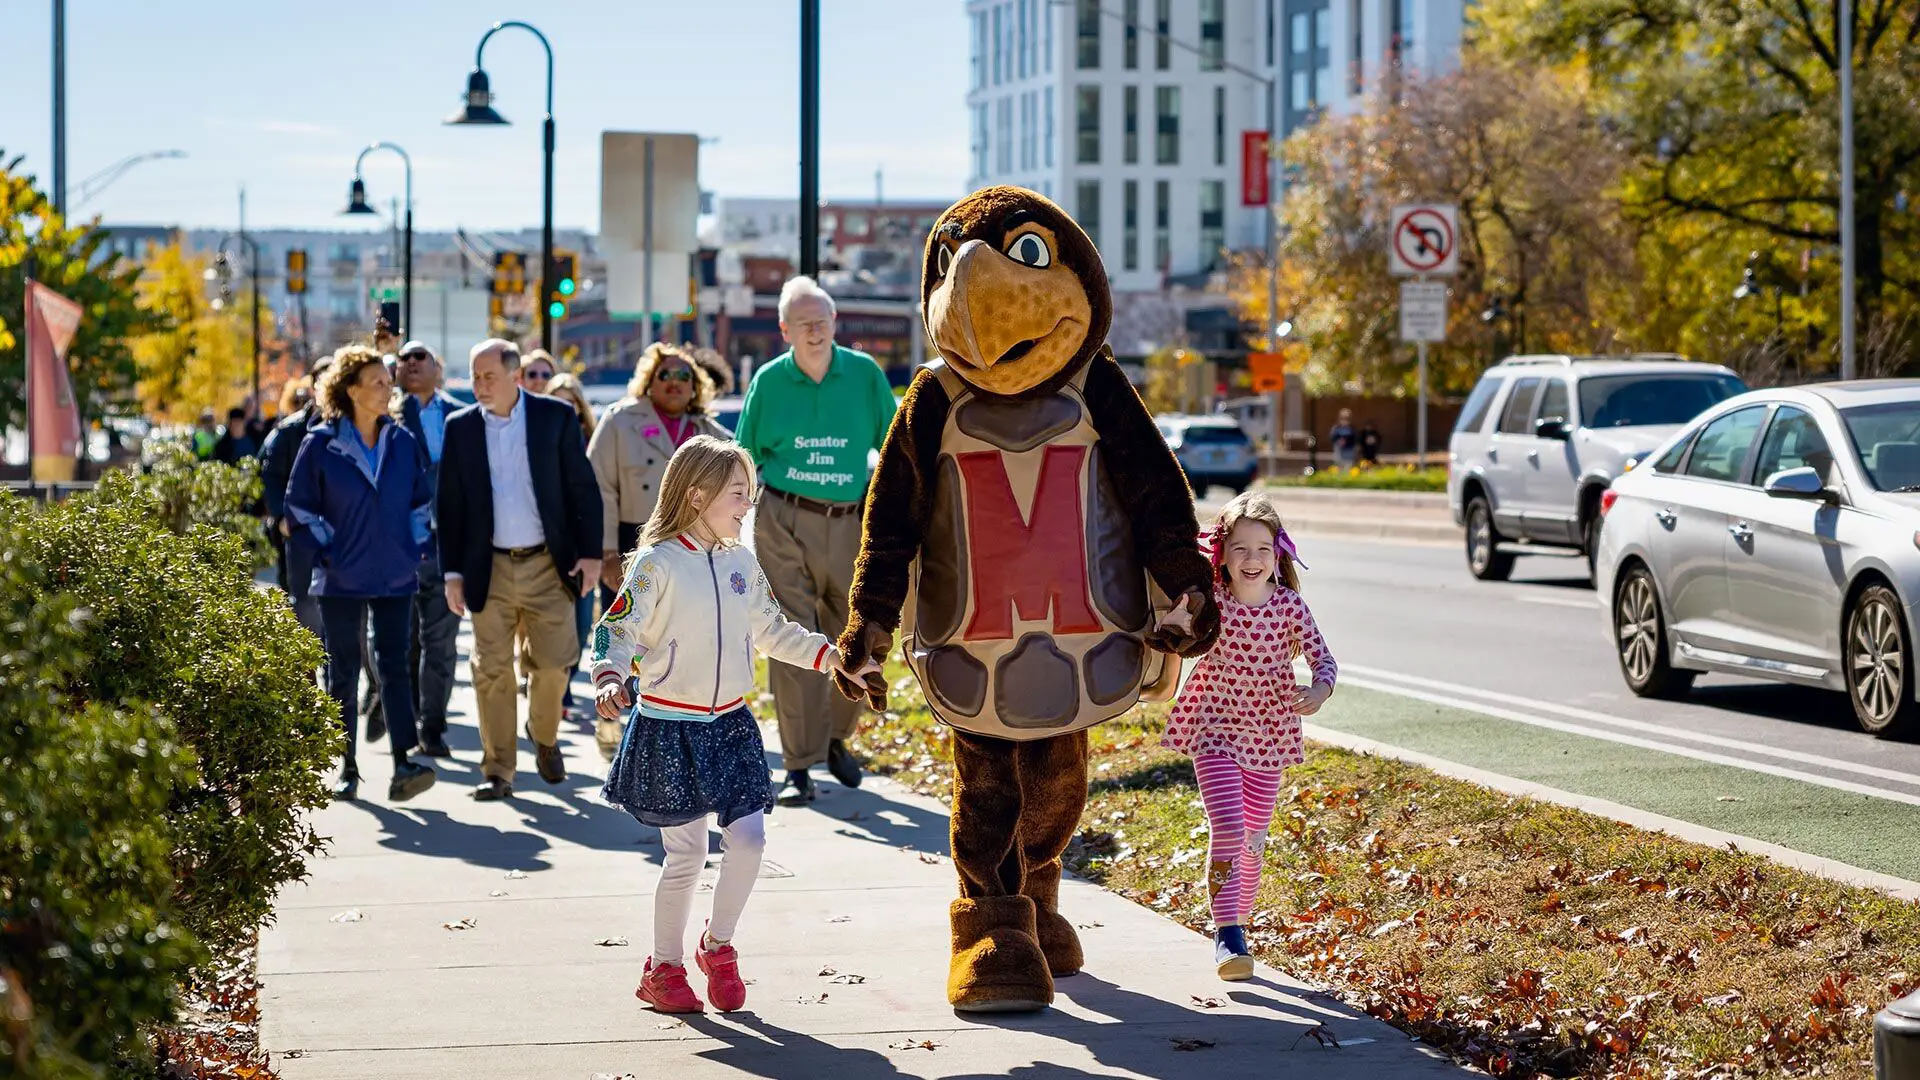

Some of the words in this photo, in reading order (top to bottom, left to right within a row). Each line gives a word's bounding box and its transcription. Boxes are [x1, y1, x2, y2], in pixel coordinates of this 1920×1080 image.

[795, 436, 848, 448] Senator
[806, 452, 834, 465] Jim
[785, 467, 853, 486] Rosapepe
[957, 445, 1104, 641] M
